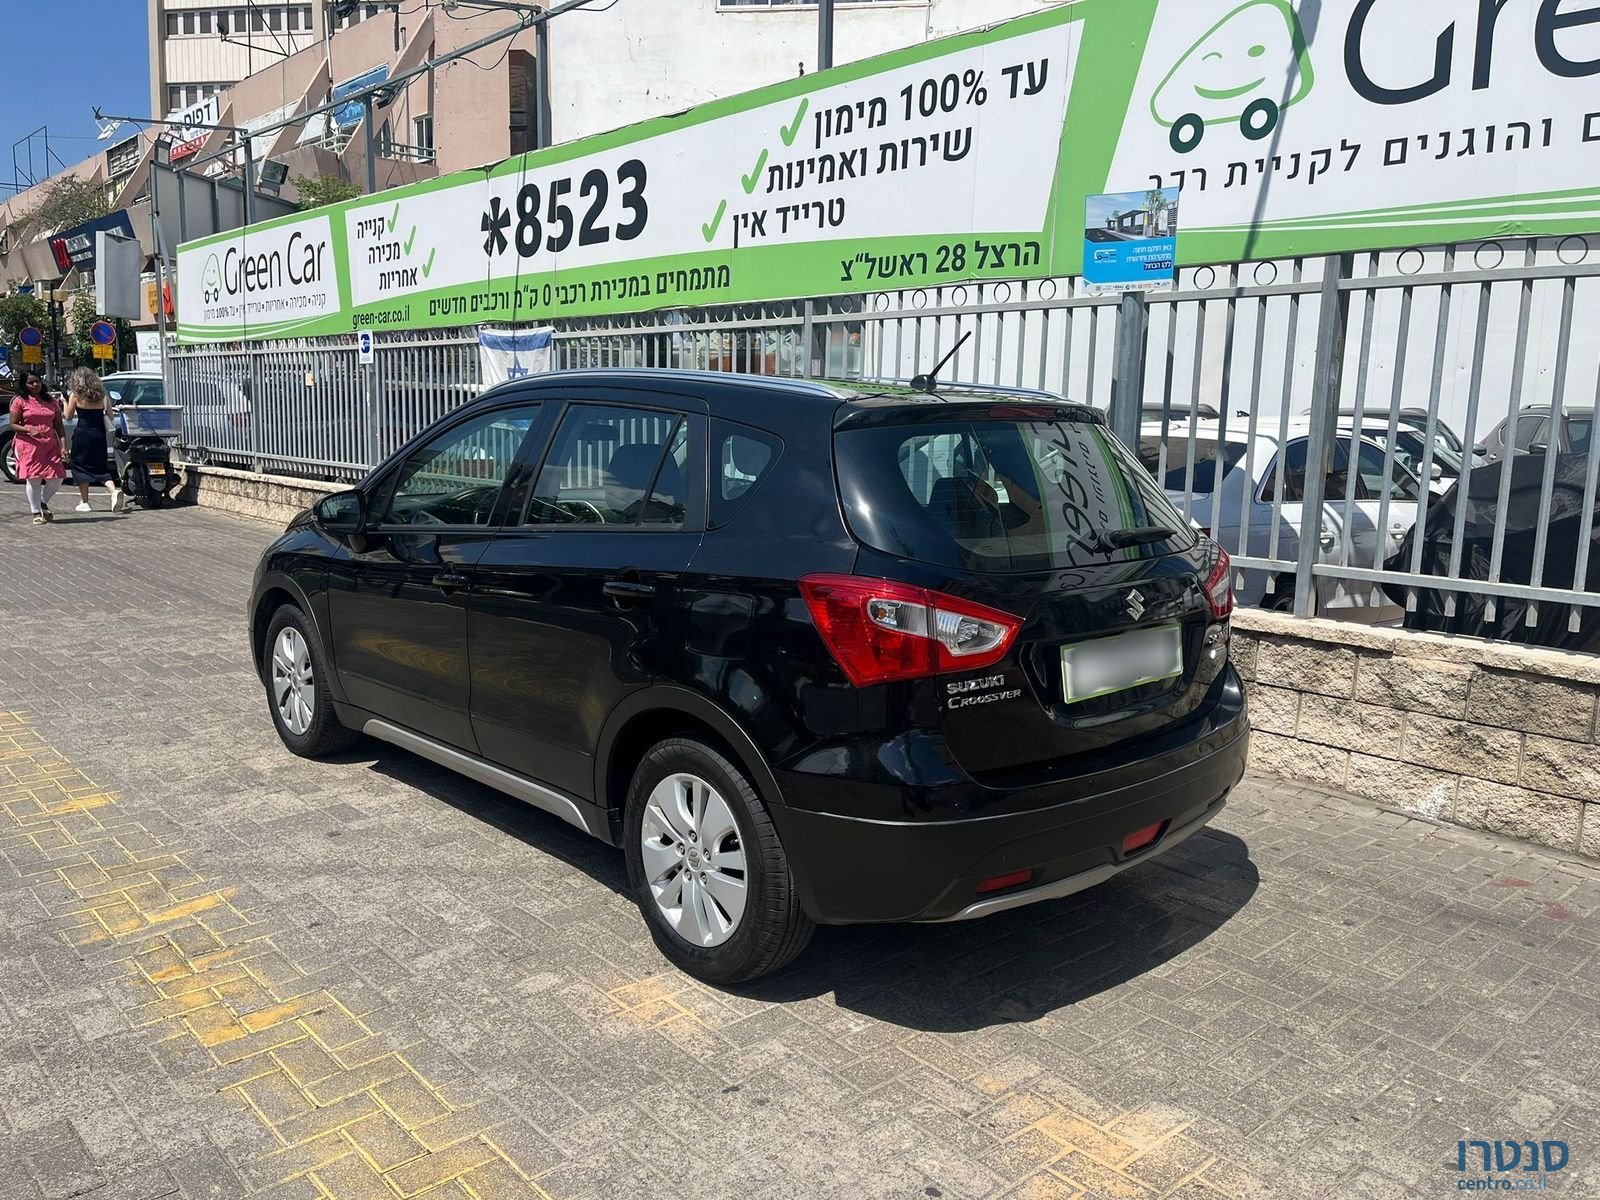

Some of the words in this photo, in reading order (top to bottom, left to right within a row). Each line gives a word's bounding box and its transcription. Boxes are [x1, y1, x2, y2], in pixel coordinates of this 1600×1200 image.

[1002, 59, 1049, 98] עד
[900, 69, 987, 121] 100%
[184, 103, 211, 131] דפוס
[814, 97, 886, 149] מימון
[877, 127, 972, 174] שירות
[1383, 118, 1552, 166] והוגנים
[767, 147, 868, 193] ואמינות
[1224, 138, 1361, 188] לקניית
[357, 216, 385, 241] קנייה
[732, 210, 767, 249] אין
[776, 198, 845, 234] טרייד
[224, 247, 281, 295] Green
[287, 231, 325, 285] Car
[368, 242, 401, 264] מכירה
[936, 246, 966, 273] 28
[975, 241, 1040, 269] הרצל
[379, 267, 418, 291] אחריות
[591, 273, 650, 301] במכירת
[656, 264, 730, 293] מתמחים
[429, 296, 467, 316] חדשים
[471, 292, 509, 312] ורכבים
[543, 284, 551, 306] 0
[555, 283, 586, 305] רכבי
[352, 304, 410, 329] green-car.co.il
[947, 674, 1005, 694] SUZUKI
